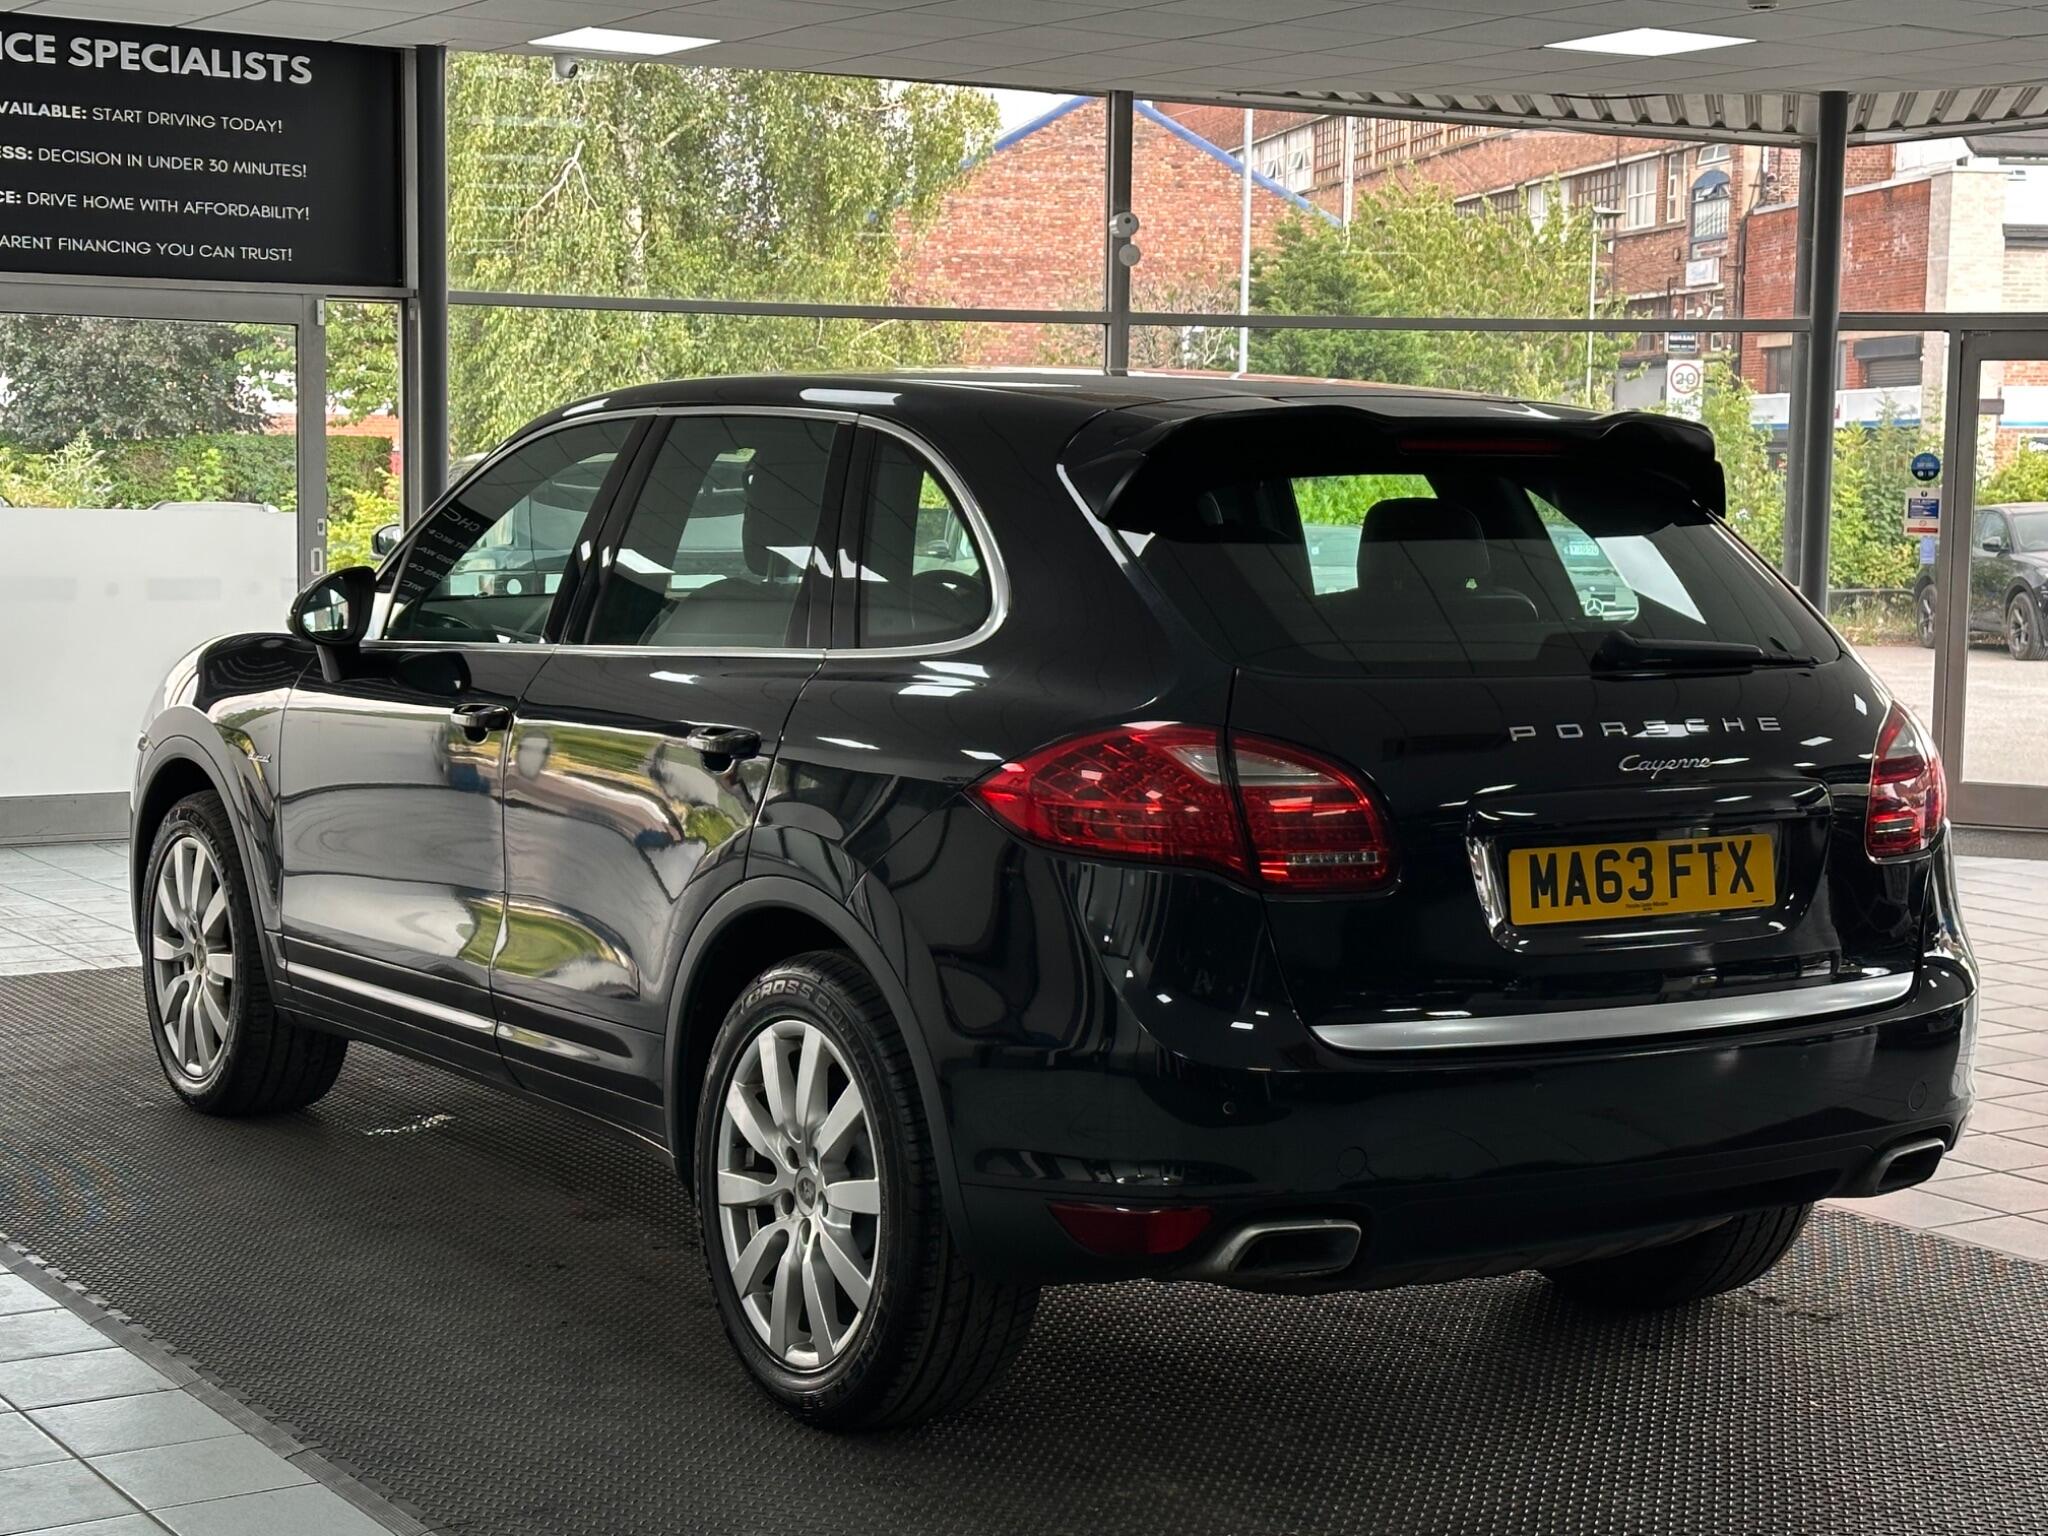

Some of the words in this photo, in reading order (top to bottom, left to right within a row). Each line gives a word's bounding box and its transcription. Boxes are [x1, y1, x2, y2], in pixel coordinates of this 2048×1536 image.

[0, 31, 56, 64] CE
[67, 37, 312, 84] SPECIALISTS
[92, 106, 142, 123] START
[147, 111, 216, 128] DRIVING
[220, 116, 283, 134] TODAY!
[0, 145, 33, 160] SS:
[38, 148, 122, 167] DECISION
[127, 153, 143, 168] IN
[147, 155, 204, 172] UNDER
[208, 158, 229, 174] 30
[233, 160, 308, 178] MINUTES!
[27, 191, 77, 208] DRIVE
[83, 195, 134, 211] HOME
[139, 198, 179, 214] WITH
[184, 200, 310, 221] AFFORDABILITY!
[0, 234, 53, 251] ARENT
[58, 237, 151, 256] FINANCING
[155, 242, 194, 258] YOU
[199, 243, 235, 260] CAN
[240, 246, 293, 262] TRUST!
[1675, 372, 1696, 386] 20
[1508, 716, 1782, 742] PORSCHE
[1618, 754, 1711, 779] Cayenne
[1529, 845, 1654, 909] MA63
[1667, 839, 1755, 899] FTX
